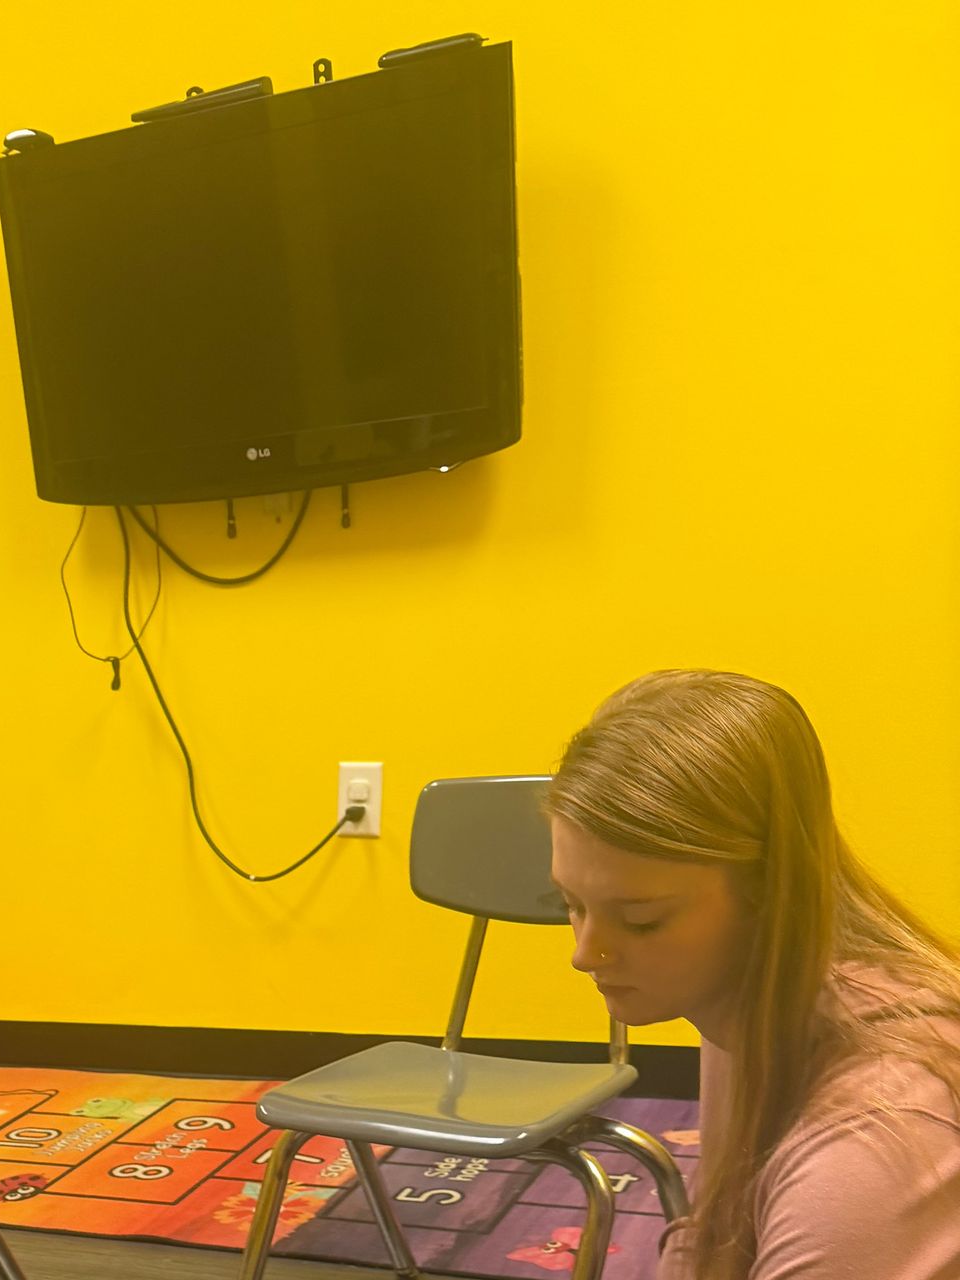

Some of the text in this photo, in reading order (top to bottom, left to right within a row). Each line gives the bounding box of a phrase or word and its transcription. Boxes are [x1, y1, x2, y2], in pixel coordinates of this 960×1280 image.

[258, 448, 271, 458] LG
[175, 1116, 235, 1131] 9
[109, 1163, 173, 1180] 8
[424, 1157, 462, 1178] Side
[448, 1158, 489, 1182] hops
[395, 1187, 463, 1205] 5
